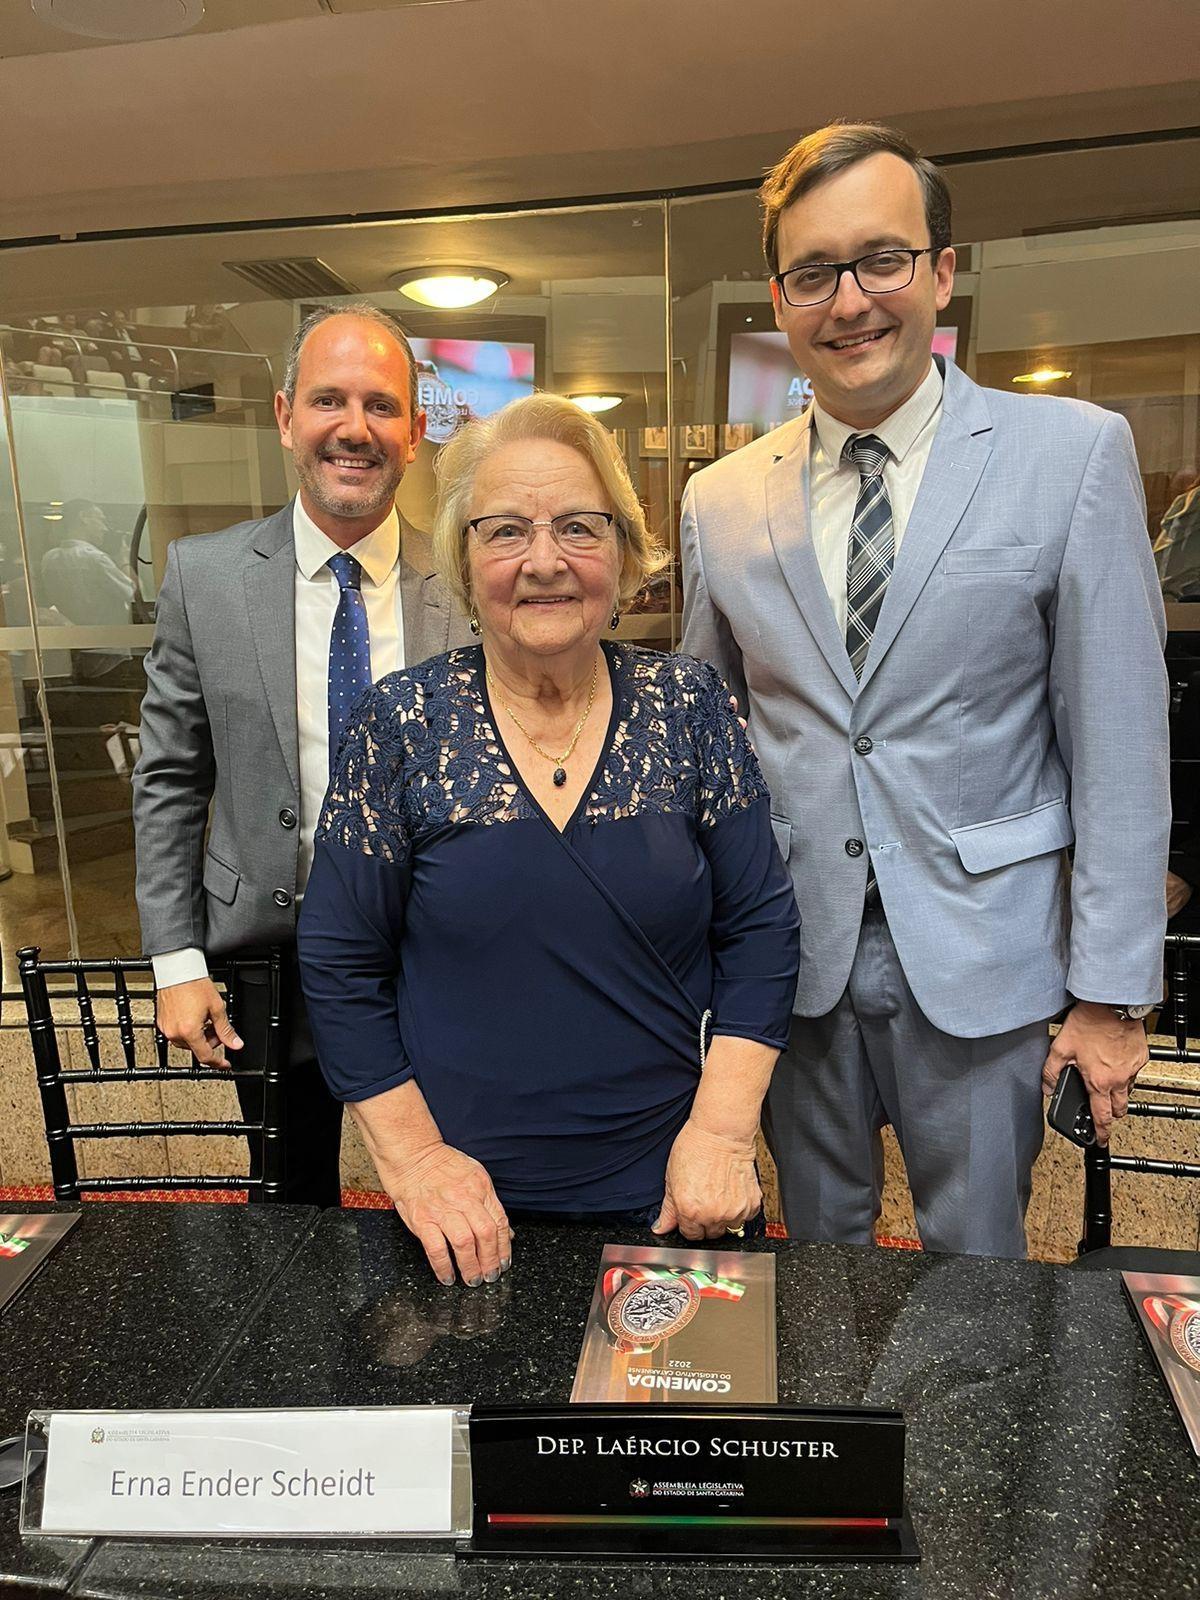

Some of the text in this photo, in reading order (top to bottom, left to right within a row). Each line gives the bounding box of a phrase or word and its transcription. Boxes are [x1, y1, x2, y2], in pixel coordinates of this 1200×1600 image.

[668, 1360, 691, 1368] 2022
[628, 1366, 673, 1376] CATARINENSE
[675, 1369, 718, 1379] LEGISLATIVO
[627, 1373, 731, 1393] COMENDA
[111, 1468, 376, 1497] Erna Ender Scheidt
[653, 1481, 744, 1490] ASSEMBLEIA LEGISLATIVA
